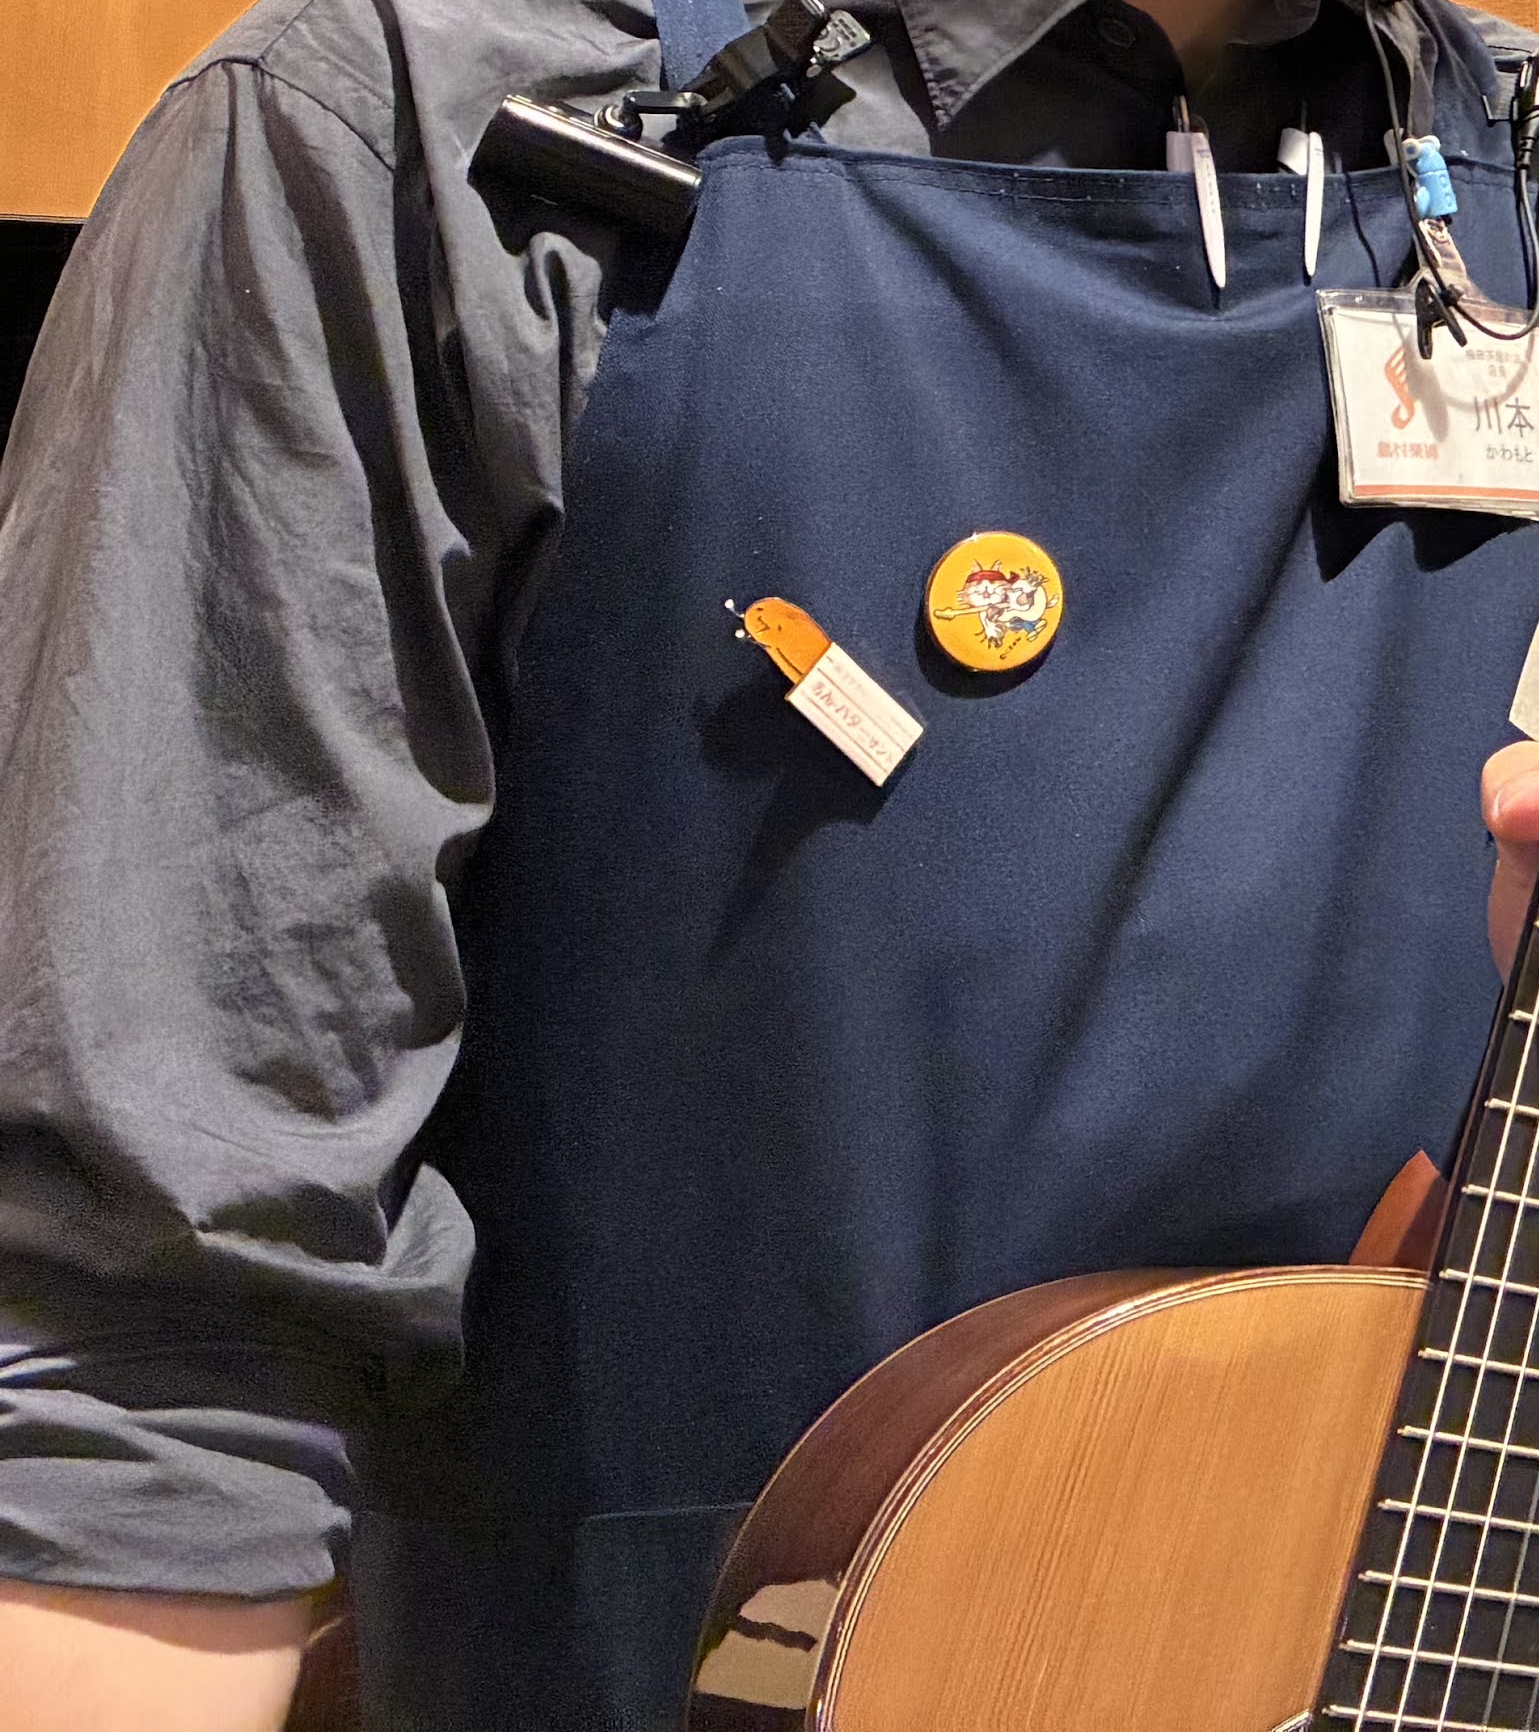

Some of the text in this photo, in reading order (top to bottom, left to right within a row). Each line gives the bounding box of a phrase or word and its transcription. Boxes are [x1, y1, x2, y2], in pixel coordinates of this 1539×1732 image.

[1474, 397, 1535, 439] 川本
[1486, 444, 1533, 463] かわもと
